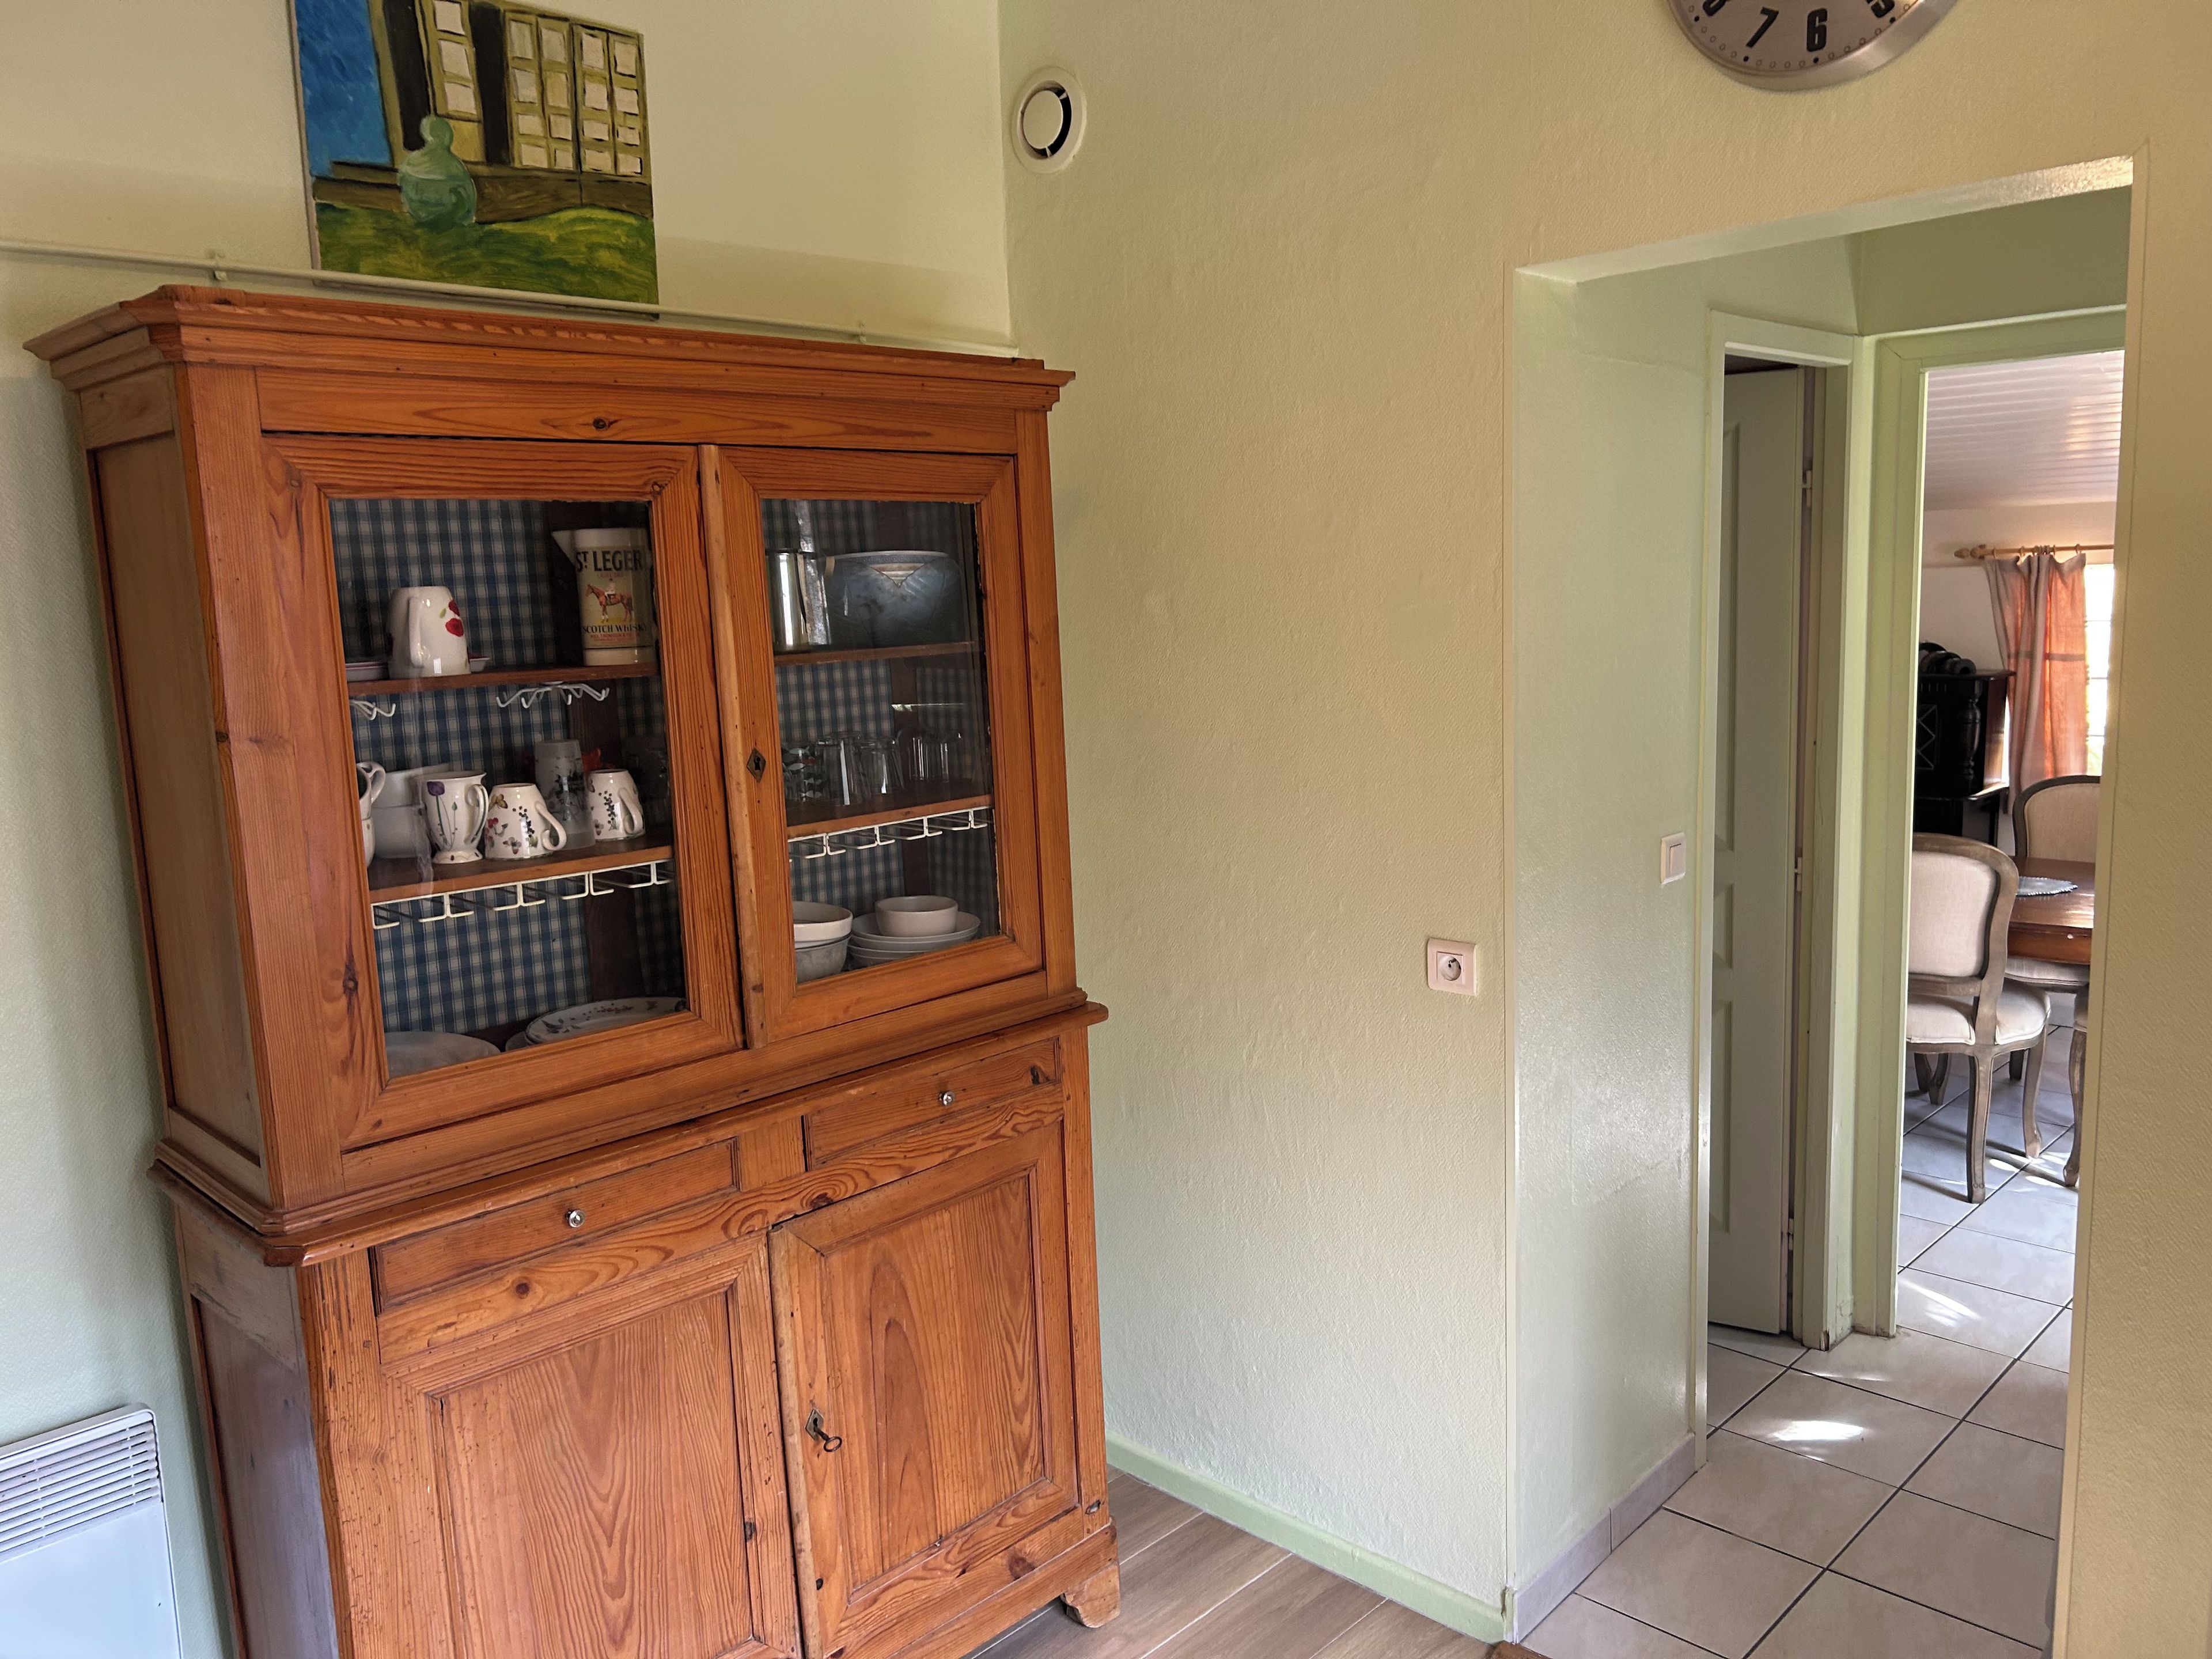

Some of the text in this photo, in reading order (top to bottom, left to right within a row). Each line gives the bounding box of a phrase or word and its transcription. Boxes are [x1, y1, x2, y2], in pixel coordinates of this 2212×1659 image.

[1745, 7, 1779, 48] 7
[1806, 7, 1828, 52] 6
[593, 550, 643, 572] LEGER
[582, 624, 613, 634] SCOTCH
